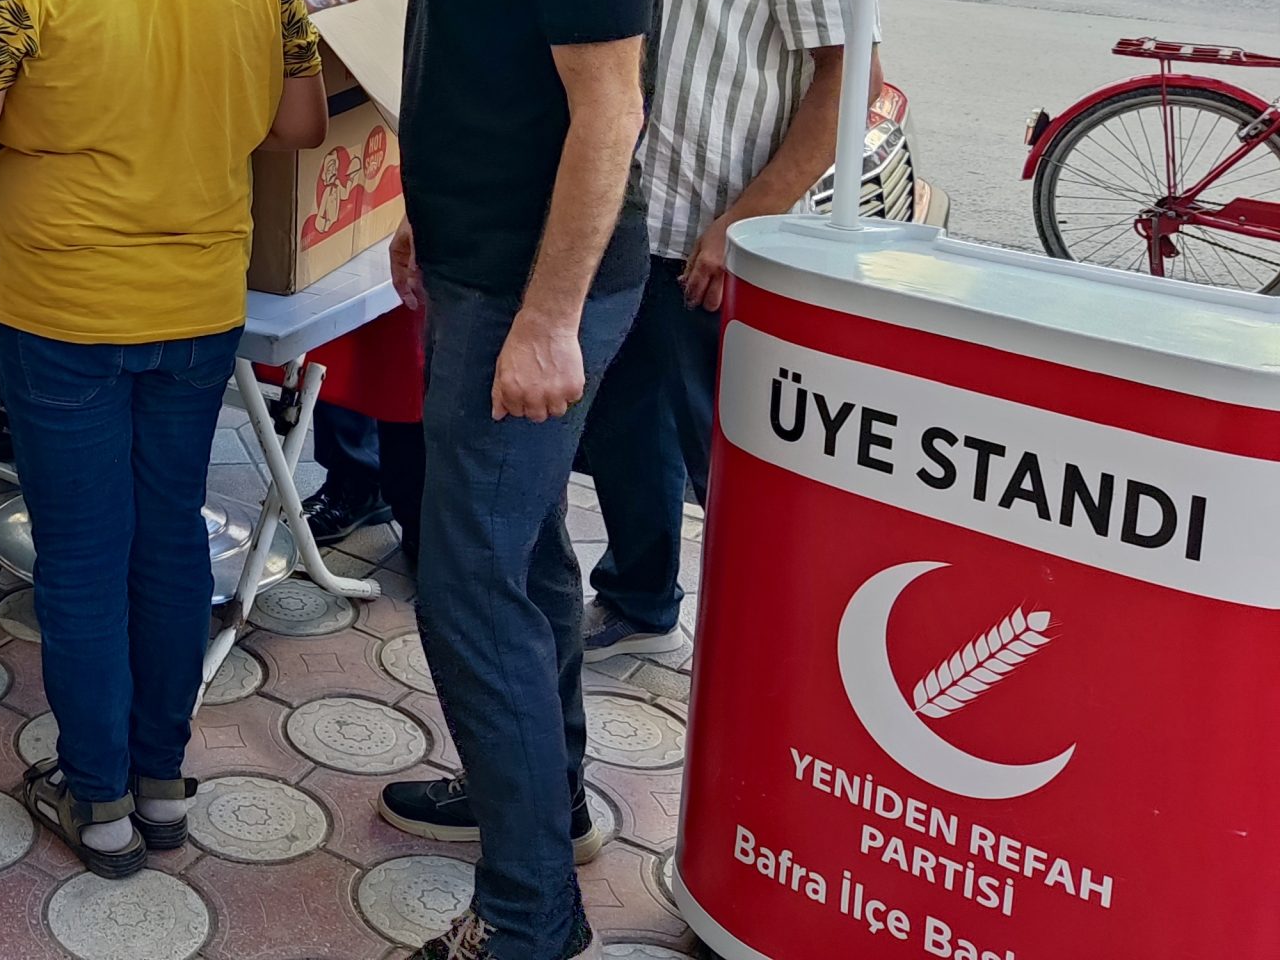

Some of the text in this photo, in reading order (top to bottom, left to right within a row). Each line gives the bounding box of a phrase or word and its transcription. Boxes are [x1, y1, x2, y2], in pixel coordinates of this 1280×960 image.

[368, 131, 384, 153] HOT
[769, 366, 1209, 563] ÜYE STANDI
[733, 823, 1015, 960] Bafra İlçe Ba
[789, 746, 1114, 910] YENİDEN REFAH
[859, 824, 1015, 918] PARTİSİ
